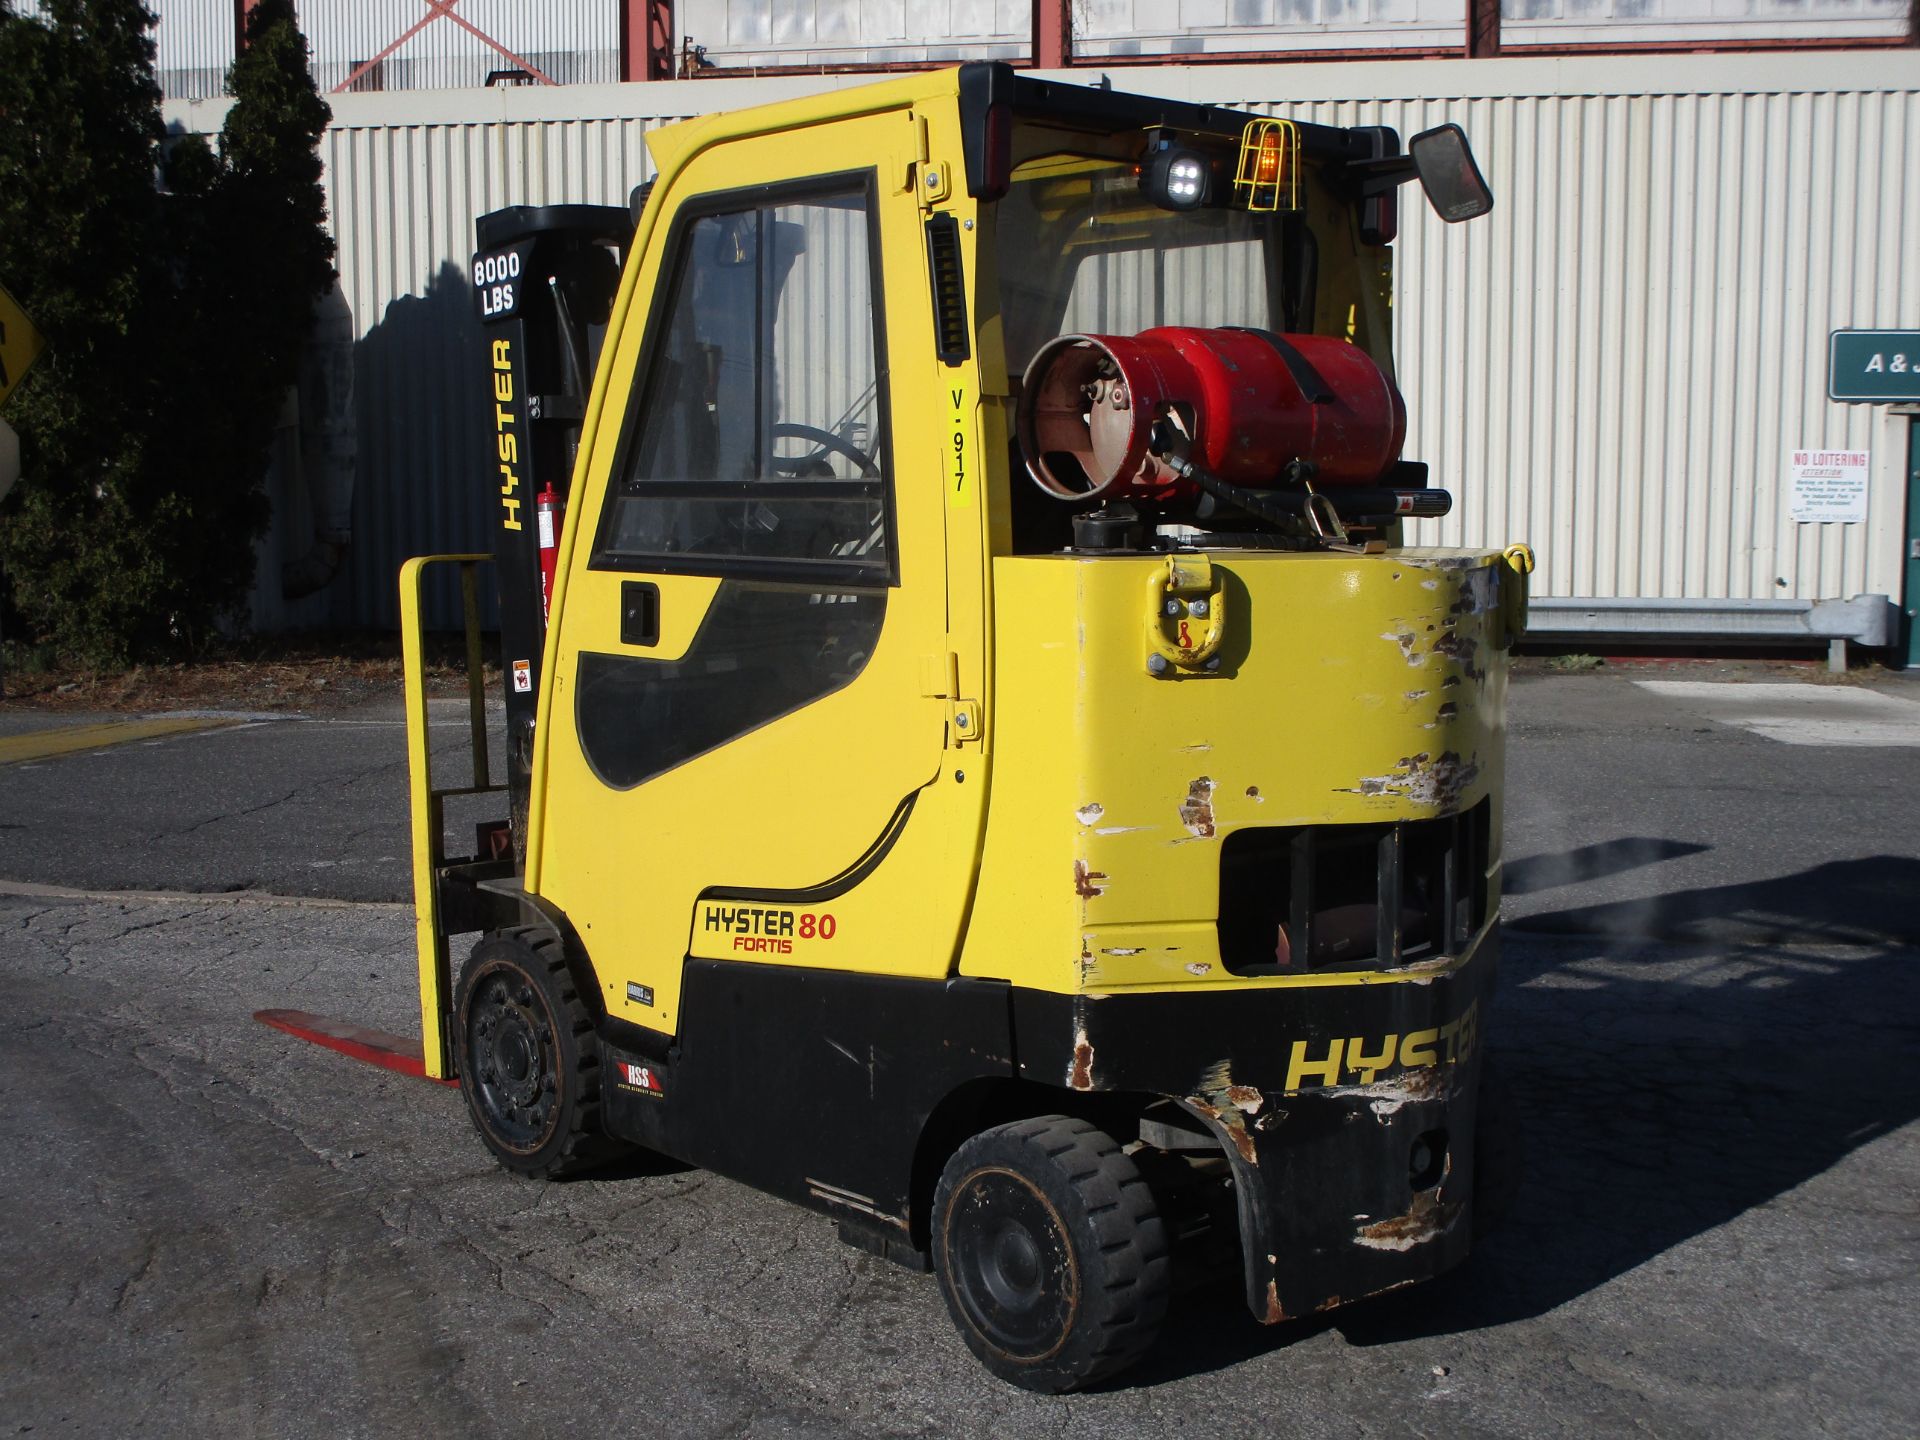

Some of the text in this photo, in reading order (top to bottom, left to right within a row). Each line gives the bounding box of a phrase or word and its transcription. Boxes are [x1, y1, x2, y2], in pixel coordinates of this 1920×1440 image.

[474, 252, 520, 286] 8000
[483, 284, 514, 315] LBS
[1863, 353, 1883, 373] A
[1889, 353, 1907, 373] &
[492, 339, 522, 531] HYSTER
[1794, 453, 1865, 467] NO LOITERING
[705, 906, 837, 940] HYSTER 80
[733, 936, 793, 955] FORTIS
[1283, 996, 1479, 1097] HYSTER
[627, 1064, 650, 1088] HSS
